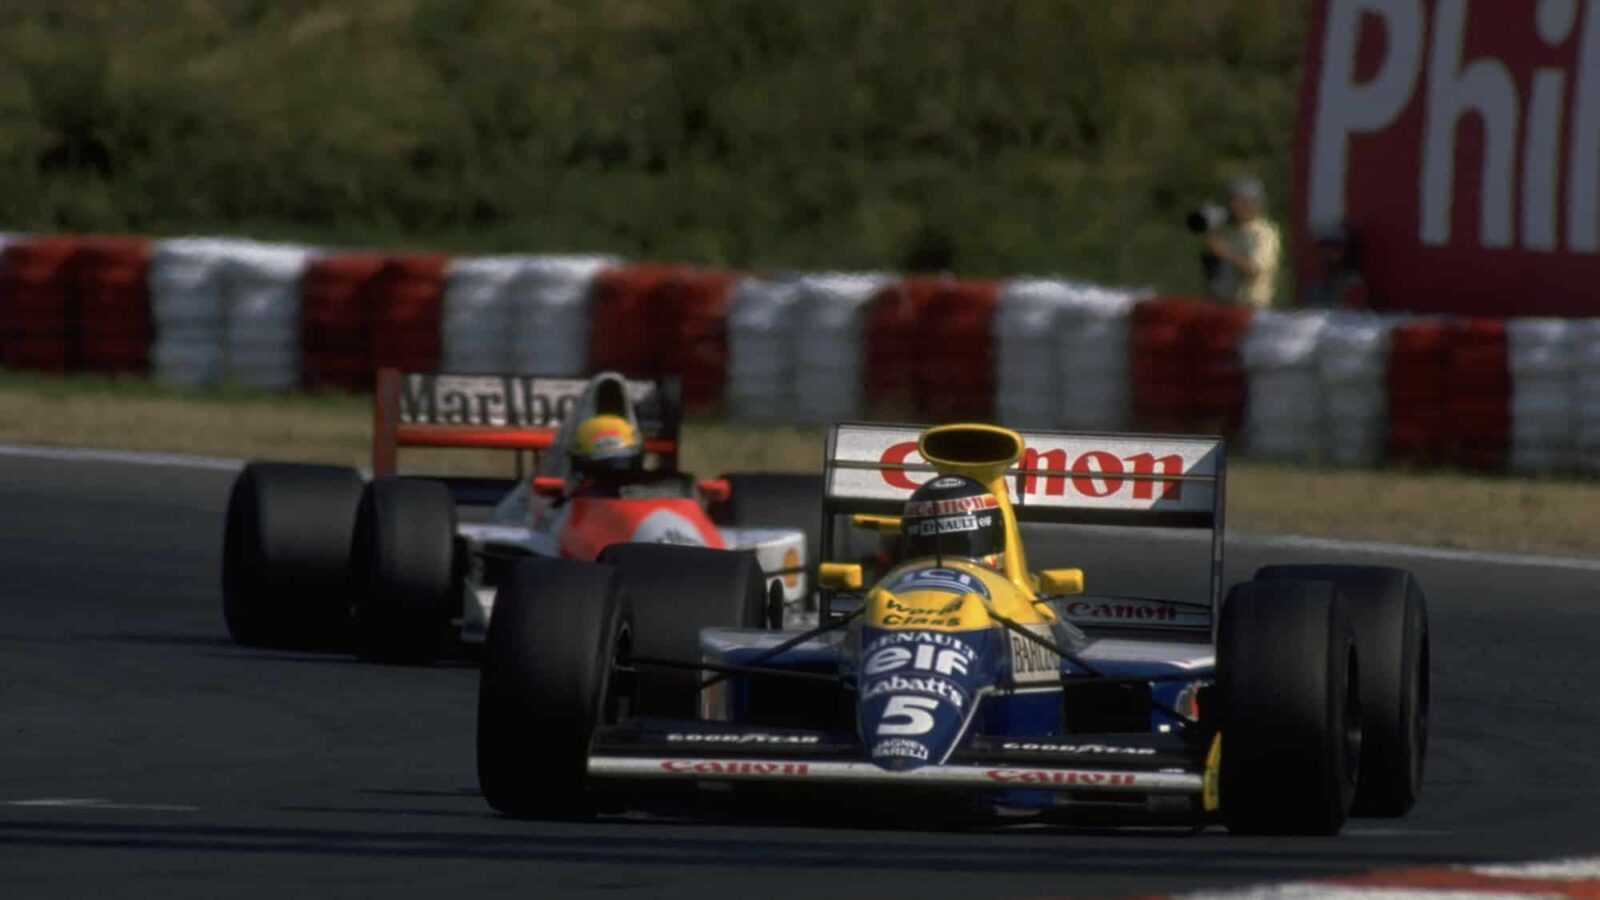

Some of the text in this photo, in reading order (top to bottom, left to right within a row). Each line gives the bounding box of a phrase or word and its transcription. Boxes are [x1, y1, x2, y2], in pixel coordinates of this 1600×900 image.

[400, 374, 578, 427] Marlbo
[880, 440, 1183, 500] Cnon
[921, 518, 974, 533] RENAULT
[902, 568, 971, 585] ICI
[887, 599, 961, 615] World
[1066, 601, 1177, 620] Canon
[883, 613, 961, 626] Class
[864, 631, 979, 661] RENAULT
[864, 644, 969, 676] elf
[863, 674, 963, 707] Labatt's
[876, 696, 940, 735] 5
[666, 733, 819, 743] GOODYEAR
[1003, 743, 1155, 754] GOODYEAR
[660, 759, 810, 774] Canon
[986, 769, 1136, 785] Canon
